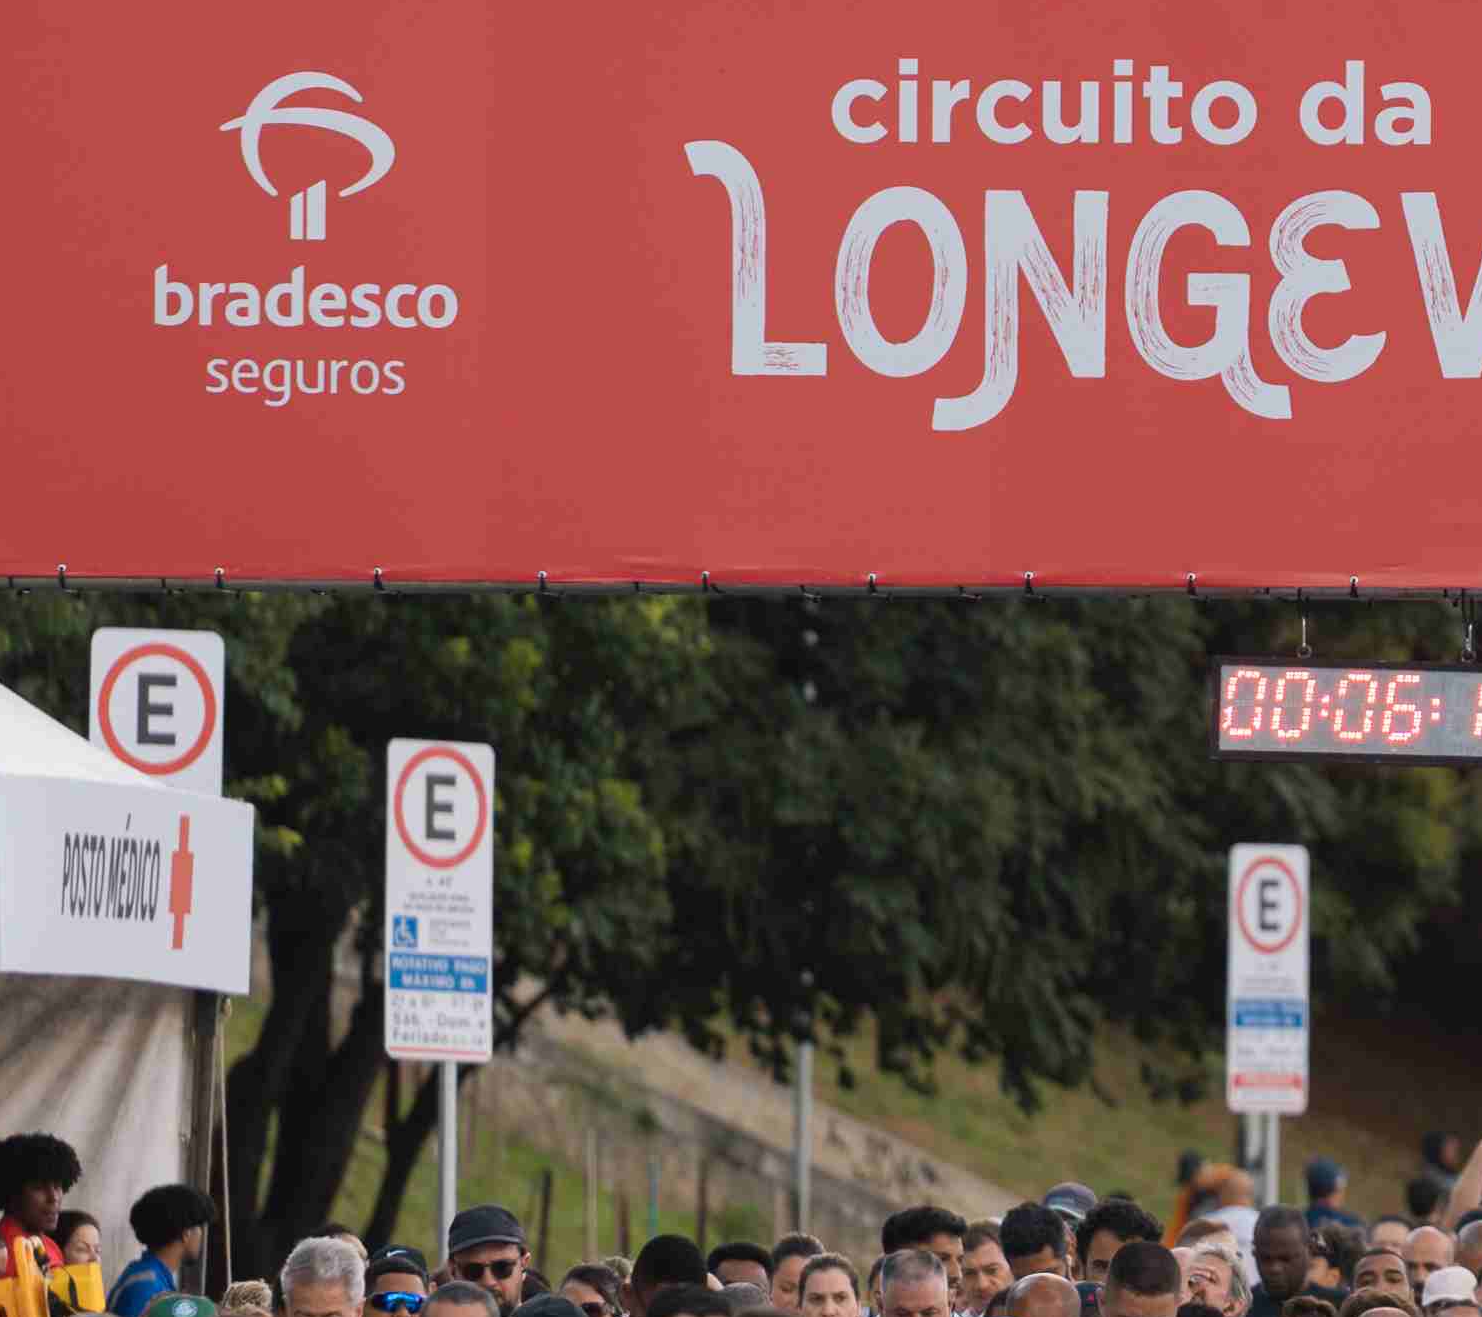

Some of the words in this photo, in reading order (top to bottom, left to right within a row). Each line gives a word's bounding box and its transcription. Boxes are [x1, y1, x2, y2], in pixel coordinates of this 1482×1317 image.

[831, 58, 1258, 146] circuito
[1299, 59, 1432, 146] da
[154, 264, 459, 329] bradesco
[205, 358, 406, 407] seguros
[136, 673, 178, 747] E
[424, 774, 457, 841] E
[61, 832, 107, 918] POSTO
[108, 814, 161, 923] MÉDICO
[1259, 879, 1280, 931] E
